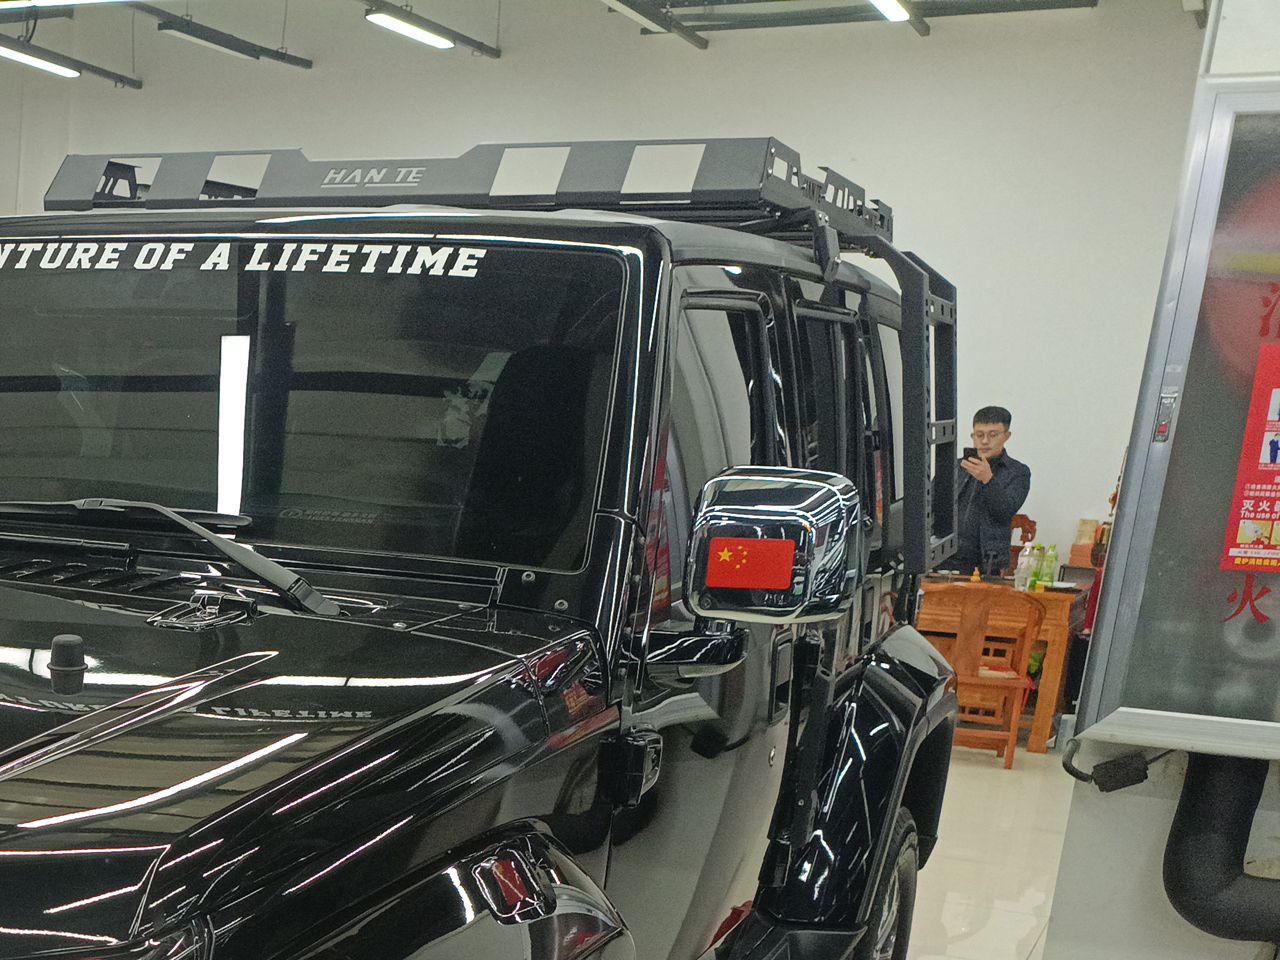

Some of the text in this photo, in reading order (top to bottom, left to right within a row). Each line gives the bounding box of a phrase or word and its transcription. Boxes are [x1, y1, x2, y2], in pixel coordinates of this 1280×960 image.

[323, 166, 427, 184] HAN TE
[133, 242, 190, 271] OF
[208, 243, 232, 271] A
[246, 244, 488, 278] LIFETIME
